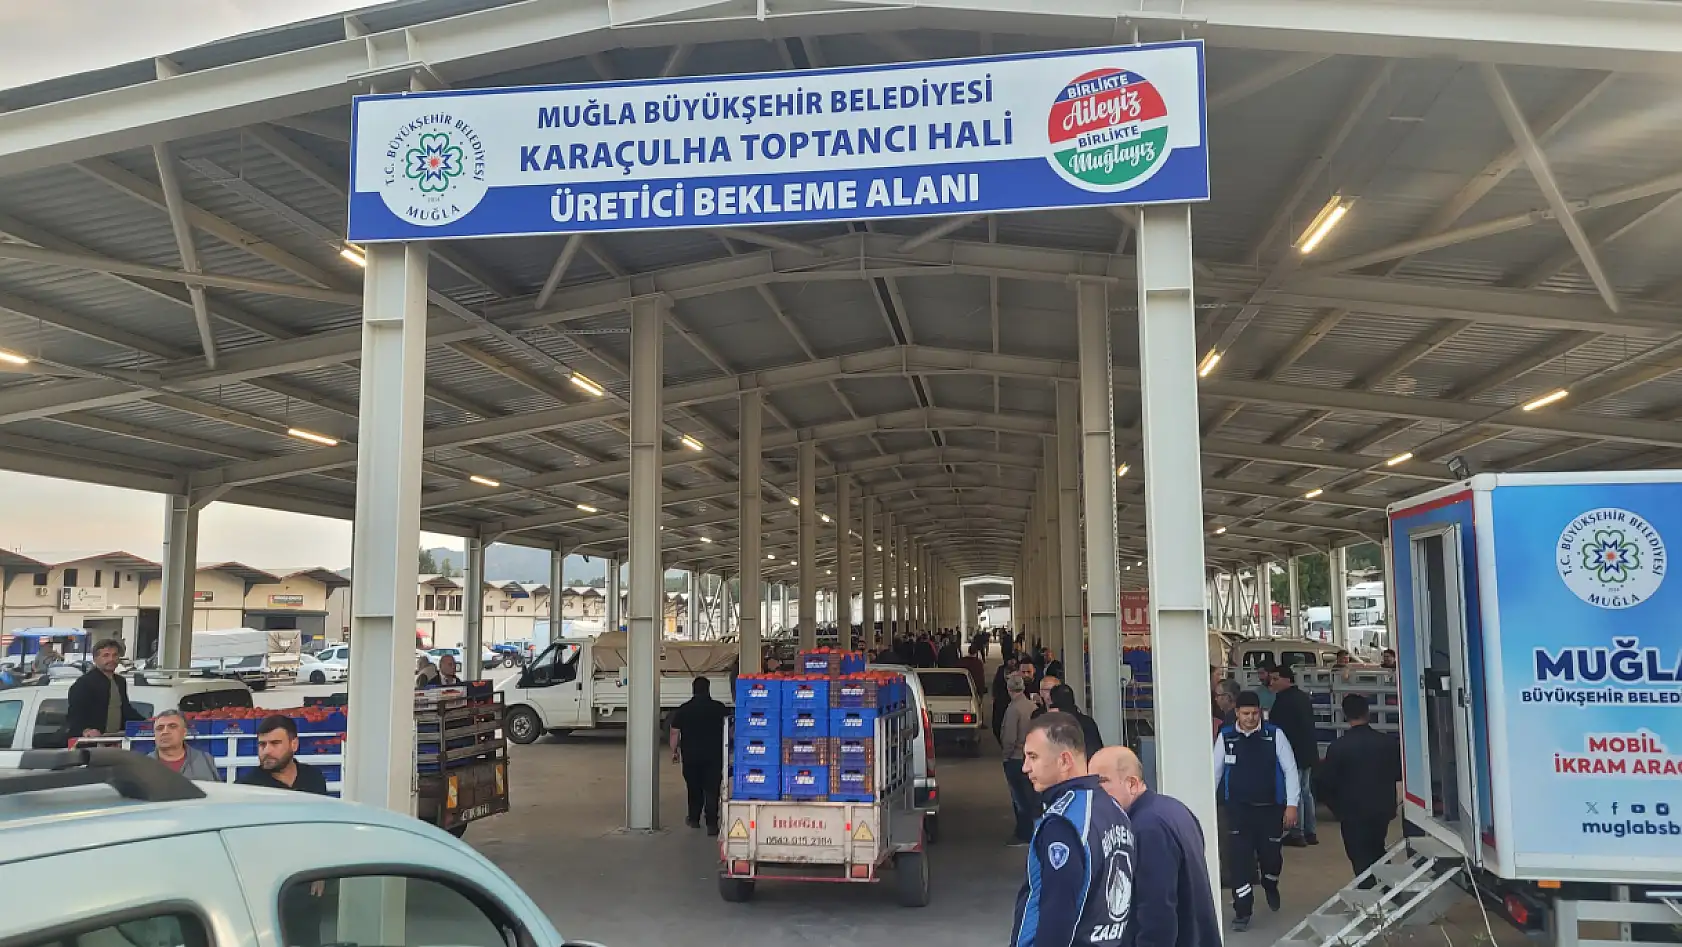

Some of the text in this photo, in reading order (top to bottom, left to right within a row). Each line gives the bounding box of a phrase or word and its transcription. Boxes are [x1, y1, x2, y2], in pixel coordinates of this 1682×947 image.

[538, 73, 993, 129] MUĞLA BÜYÜKŞEHİR BELEDİYESİ
[1067, 73, 1129, 99] BİRLİKTE
[1062, 87, 1142, 132] Aileyiz
[387, 112, 453, 158] BÜYÜKŞEHİR
[455, 119, 486, 182] BELEDİYESİ
[520, 110, 1013, 175] KARAÇULHA TOPTANCI HALİ
[1078, 124, 1140, 150] BİRLİKTE
[1068, 138, 1157, 175] Muğlayız
[406, 204, 461, 221] MUĞLA
[550, 173, 980, 223] ÜRETİCİ BEKLEME ALANI
[1561, 510, 1626, 551] BÜYÜKŞEHİR
[1629, 517, 1665, 576] BELEDİYESİ
[1587, 593, 1640, 607] MUĞLA
[1535, 639, 1682, 682] MUĞL
[1522, 687, 1682, 706] BÜYÜKŞEHİR BELED
[1588, 733, 1663, 754] MOBİL
[1554, 753, 1626, 774] İKRAM
[1582, 820, 1682, 838] muglabsb
